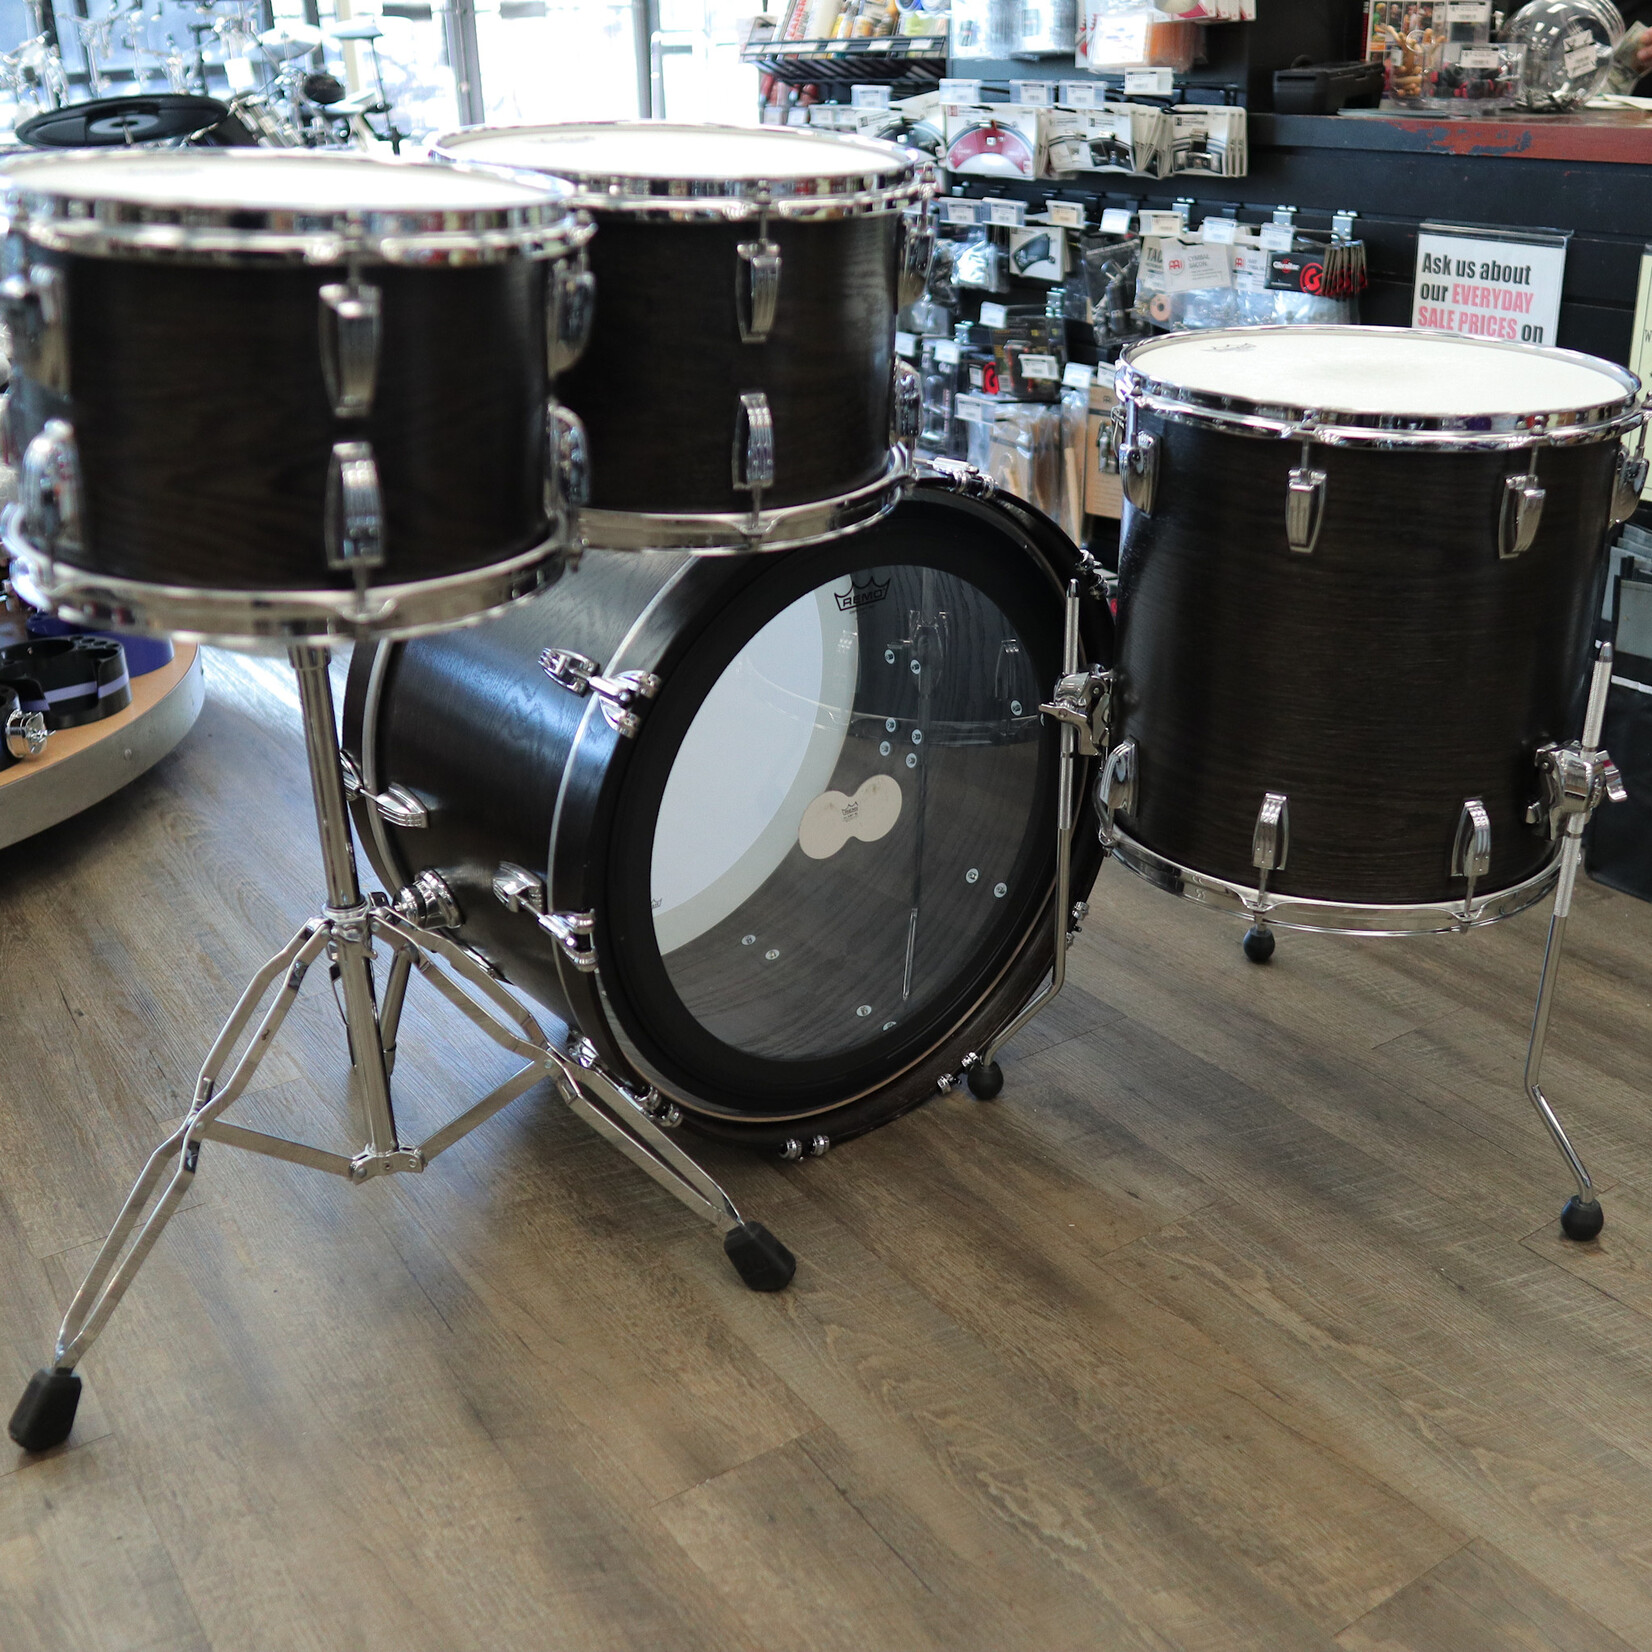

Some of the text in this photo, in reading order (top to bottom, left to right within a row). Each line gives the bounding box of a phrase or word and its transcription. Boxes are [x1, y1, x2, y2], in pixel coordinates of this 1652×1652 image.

[1422, 252, 1532, 285] Ask us about
[1420, 283, 1534, 314] our EVERYDAY
[1418, 306, 1544, 344] SALE PRICES on
[843, 588, 883, 607] REMO
